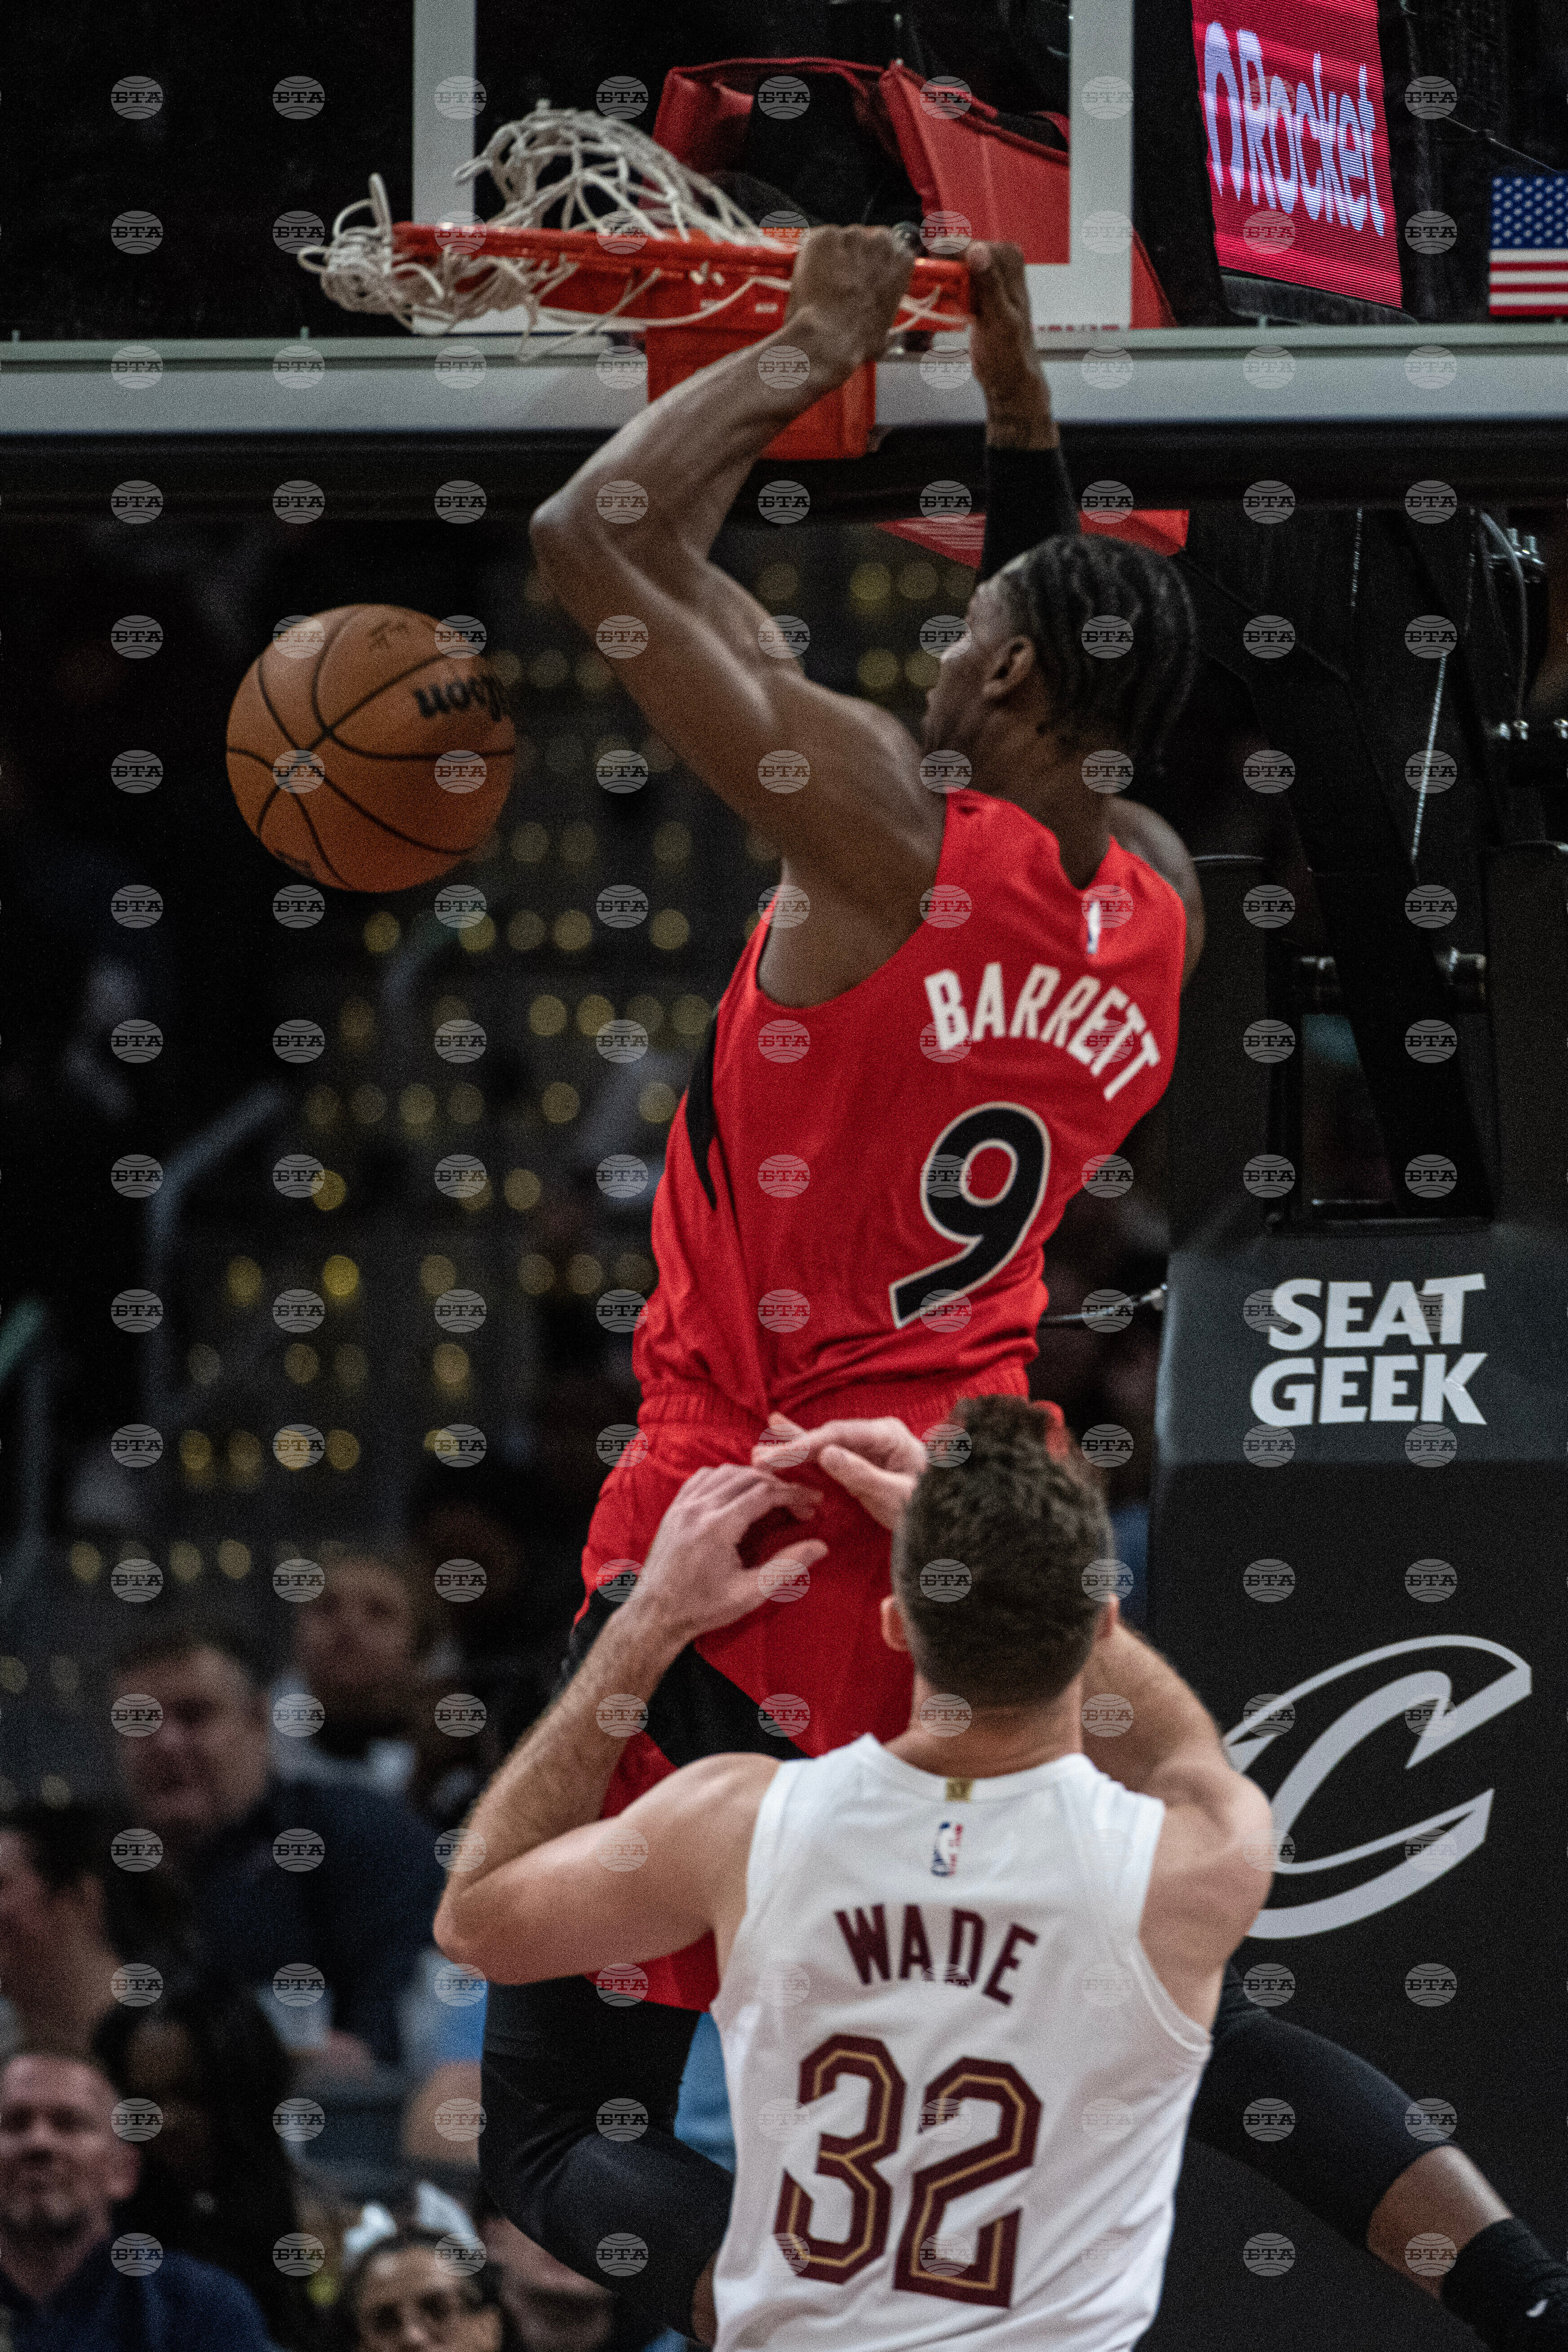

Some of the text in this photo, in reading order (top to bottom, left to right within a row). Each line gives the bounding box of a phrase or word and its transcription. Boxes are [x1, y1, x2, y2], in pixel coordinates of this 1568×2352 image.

[1236, 29, 1385, 237] Rocket
[924, 962, 1160, 1101] BARRETT
[889, 1101, 1051, 1329] 9
[1268, 1273, 1486, 1350] SEAT
[1250, 1353, 1488, 1427] GEEK
[834, 1903, 1038, 2006] WADE
[772, 2033, 1042, 2308] 32
